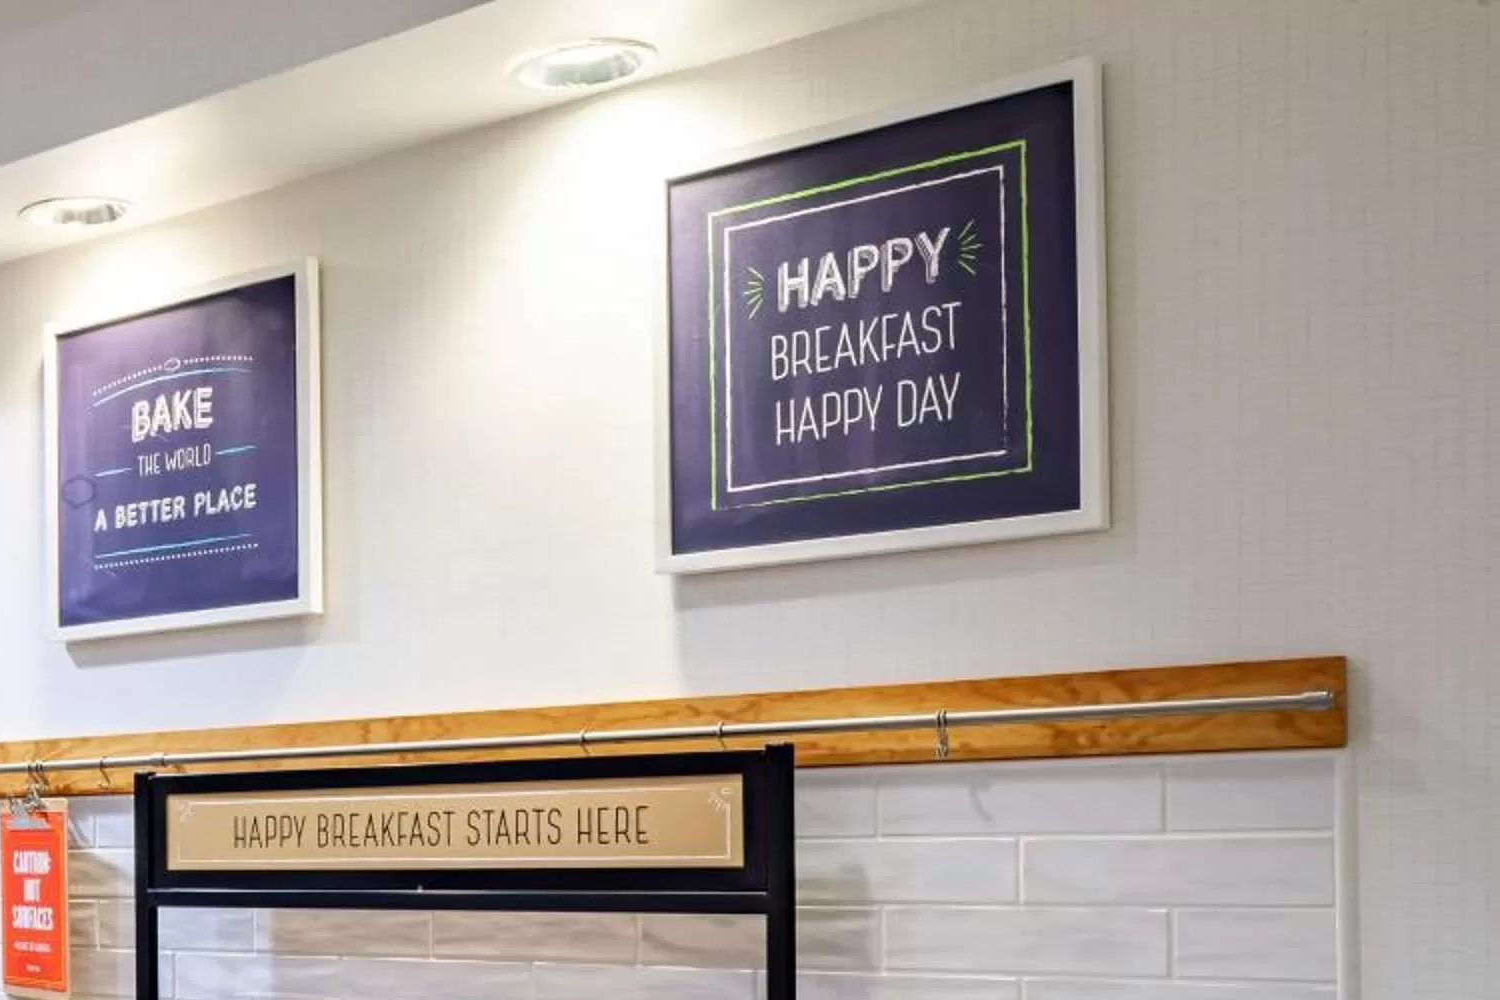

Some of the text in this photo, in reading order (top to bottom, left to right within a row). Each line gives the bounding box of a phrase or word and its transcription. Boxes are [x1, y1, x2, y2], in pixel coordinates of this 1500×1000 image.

[777, 226, 951, 312] HAPPY
[771, 301, 961, 381] BREAKFAST
[131, 386, 214, 443] BAKE
[775, 372, 961, 446] HAPPY DAY
[137, 443, 212, 477] THE WORLD
[94, 483, 257, 532] A BETTER PLACE
[233, 804, 650, 849] HAPPY BREAKFAST STARTS HERE
